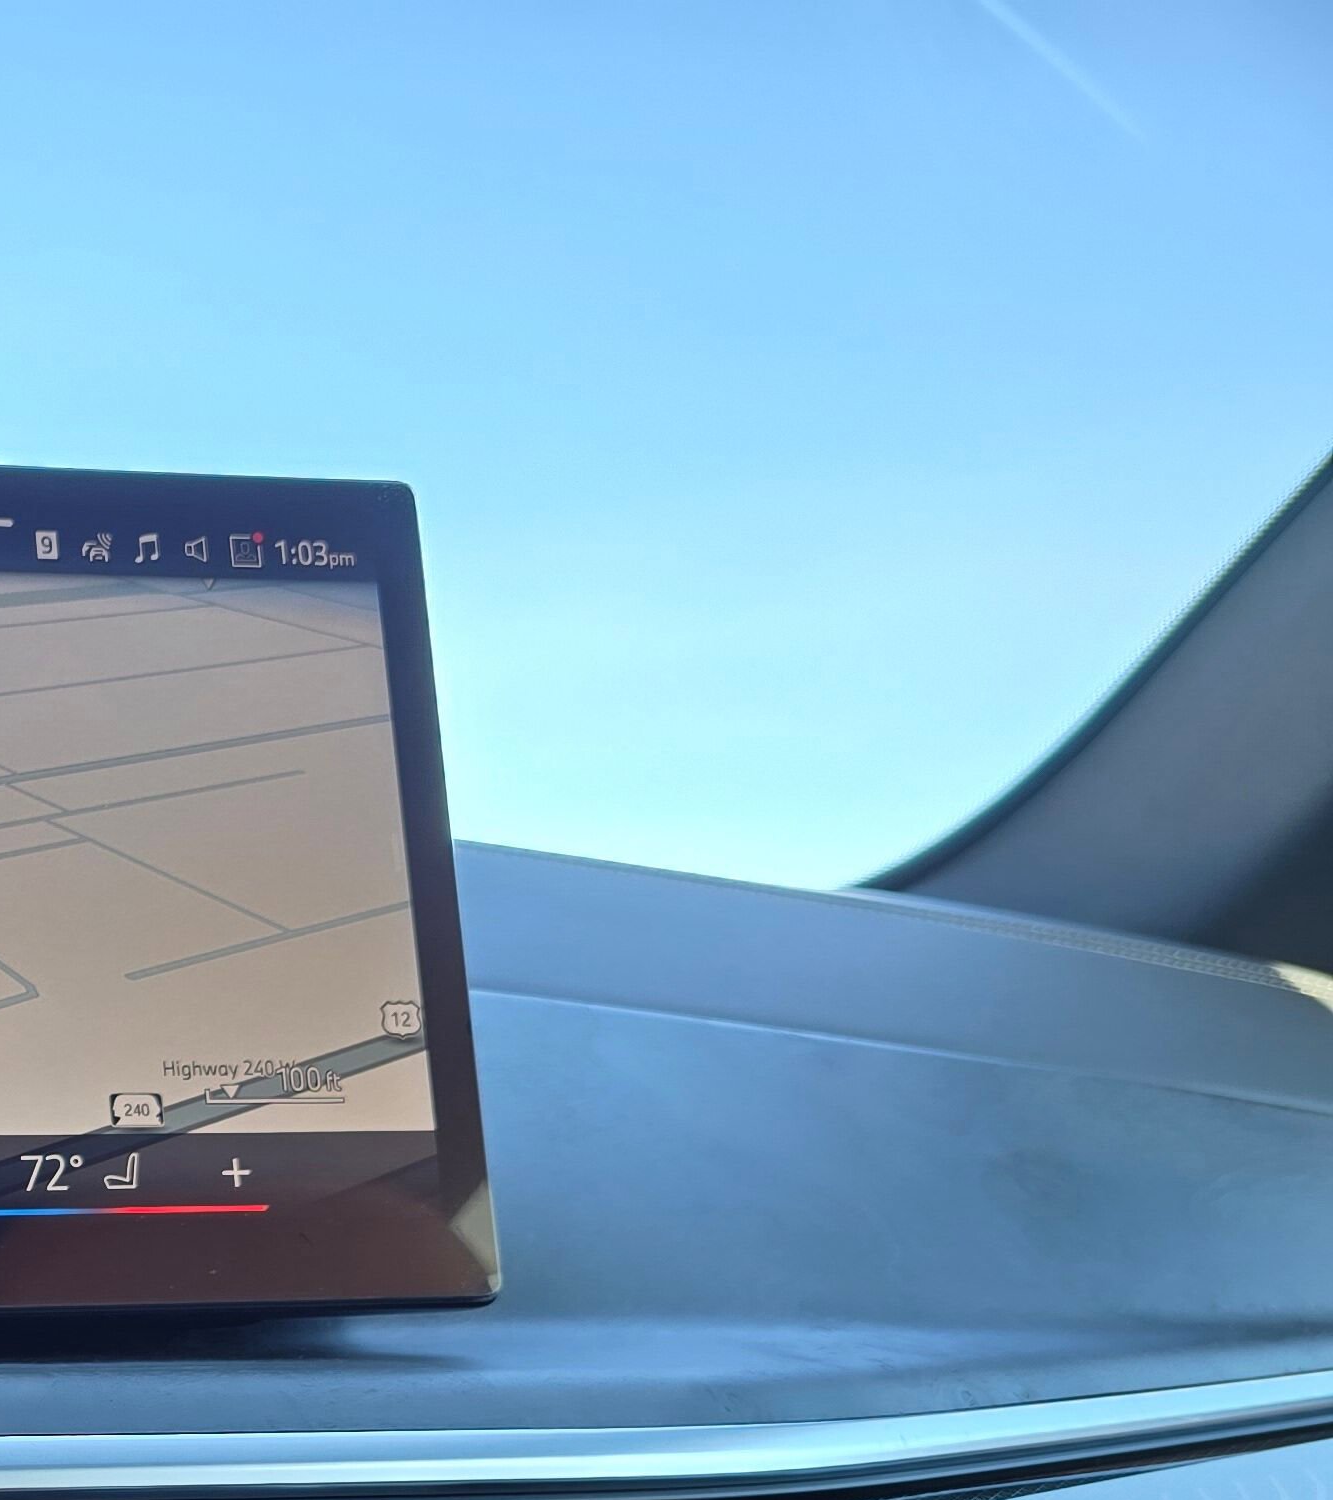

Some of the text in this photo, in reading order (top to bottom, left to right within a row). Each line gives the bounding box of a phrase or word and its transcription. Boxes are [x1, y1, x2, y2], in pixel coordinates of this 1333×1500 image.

[274, 539, 356, 570] 1:03pm
[391, 1011, 412, 1028] 12
[162, 1060, 239, 1081] Highway
[243, 1059, 275, 1077] 240
[275, 1066, 343, 1093] 100 ft
[124, 1102, 151, 1118] 240
